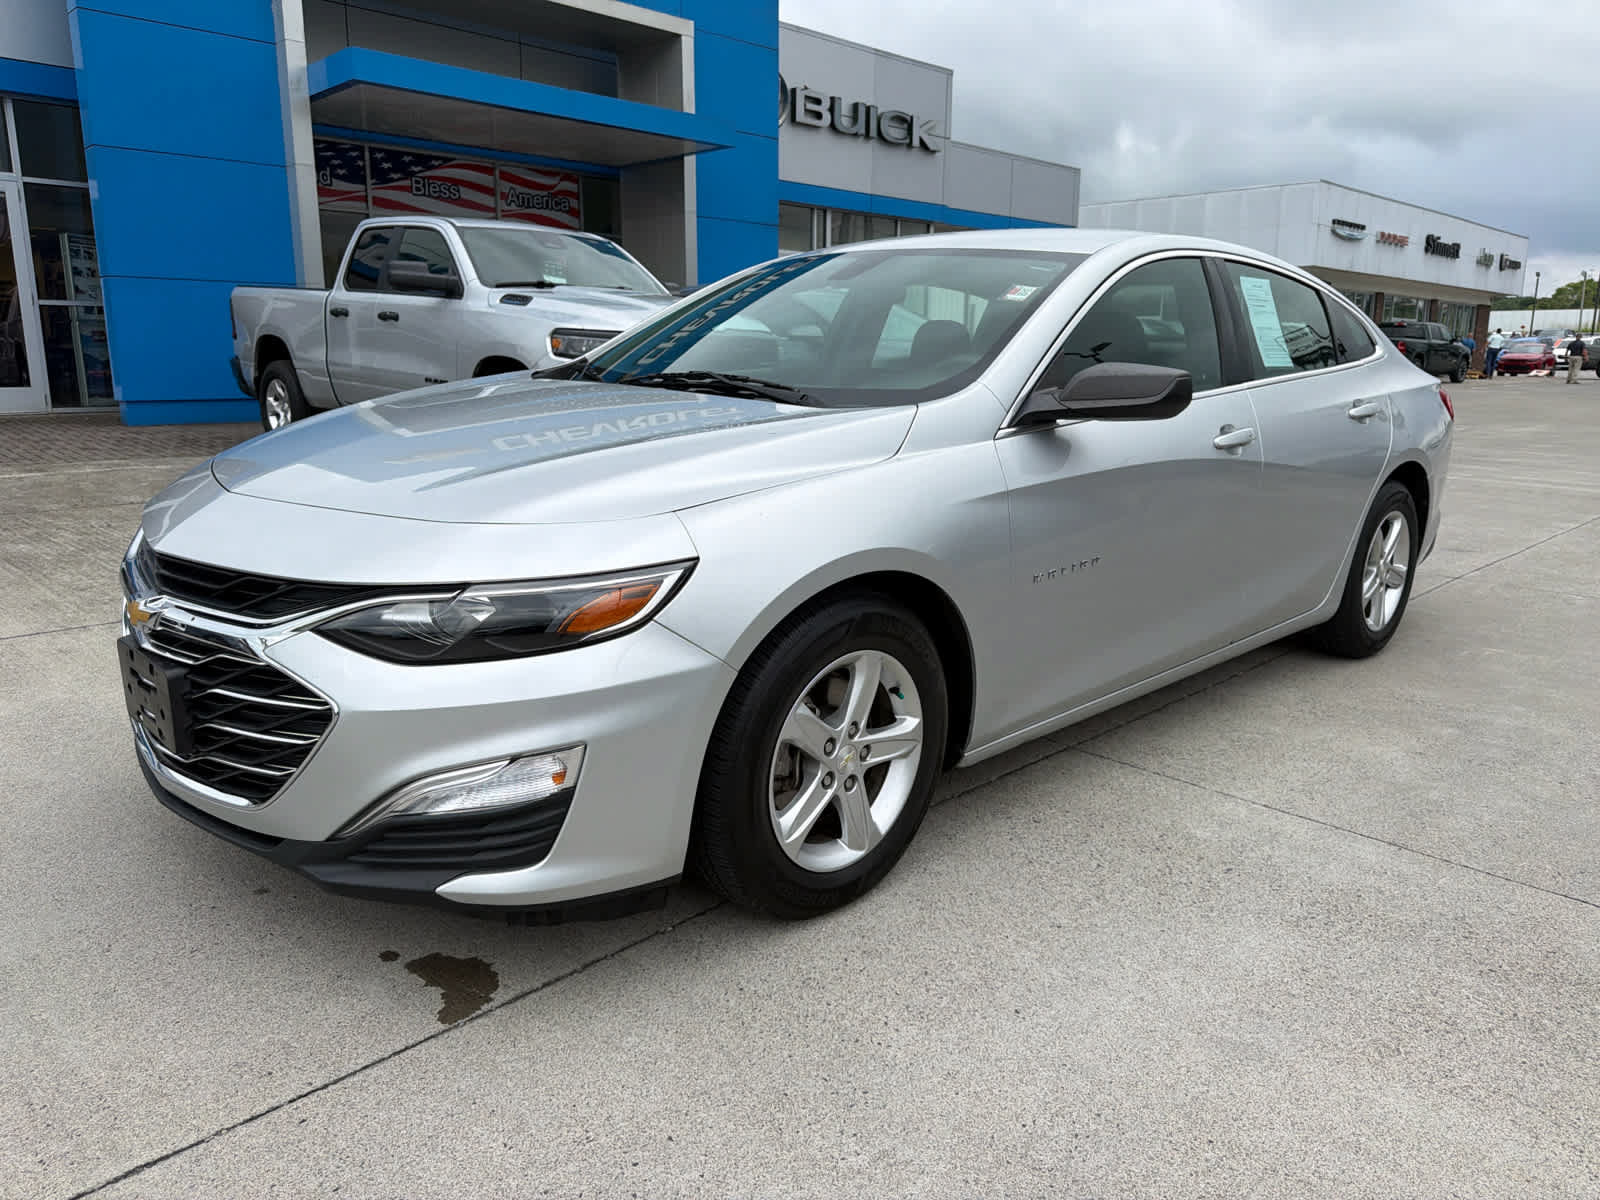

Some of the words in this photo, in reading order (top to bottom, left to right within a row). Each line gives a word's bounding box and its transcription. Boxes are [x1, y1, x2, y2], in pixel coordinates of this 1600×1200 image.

[790, 86, 941, 153] BUICK
[318, 167, 332, 187] d
[410, 176, 461, 200] Bless
[506, 187, 571, 212] America
